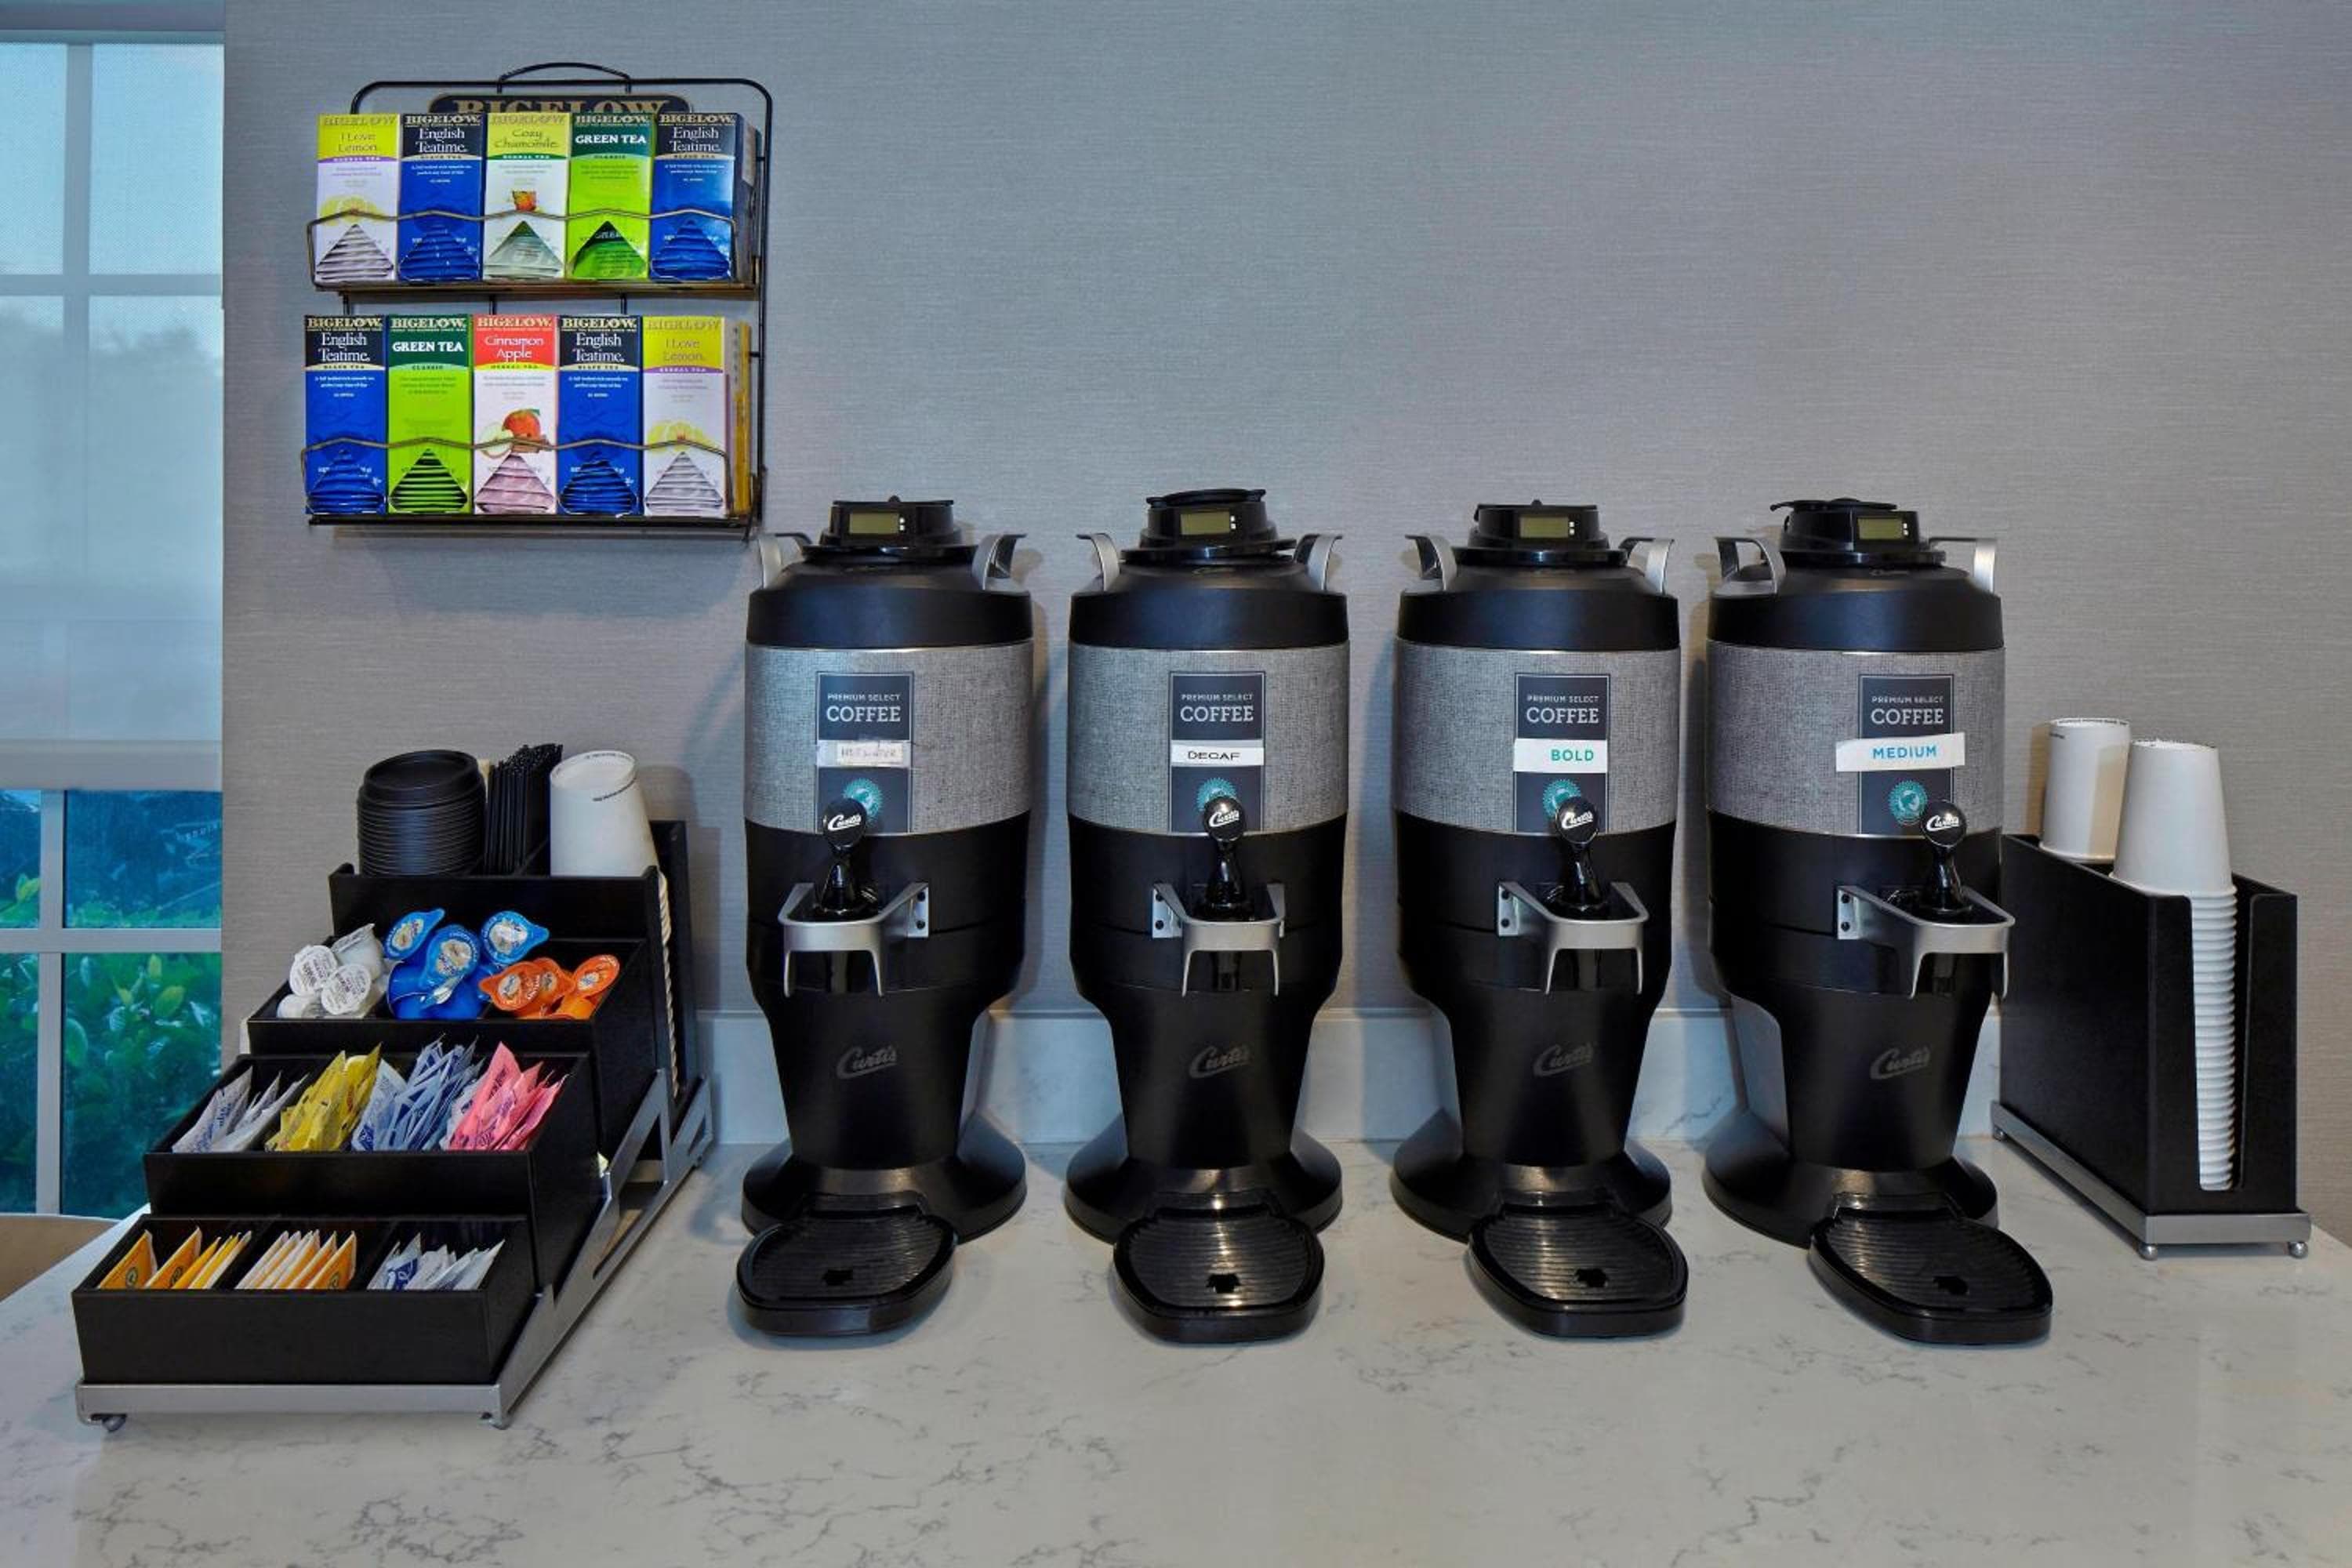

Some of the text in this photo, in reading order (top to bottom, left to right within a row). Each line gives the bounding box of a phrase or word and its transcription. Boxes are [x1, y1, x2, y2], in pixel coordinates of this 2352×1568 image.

[405, 114, 481, 124] BIGELOW
[575, 115, 649, 125] BIGELOW
[659, 114, 735, 124] BIGELOW
[419, 127, 465, 142] English
[511, 129, 543, 140] Cozy
[575, 134, 647, 144] GREEN TEA
[673, 126, 719, 141] English
[307, 318, 383, 328] BIGELOW
[391, 318, 466, 328] BIGELOW
[477, 317, 552, 328] BIGELOW
[562, 318, 637, 328] BIGELOW
[321, 332, 368, 349] English
[485, 333, 544, 347] Cinnamon
[575, 332, 622, 348] English
[392, 341, 464, 352] GREEN TEA
[495, 347, 532, 363] Apple
[827, 693, 901, 702] PREMIUM SELECT
[1222, 693, 1253, 702] SELECT
[1526, 695, 1599, 703] PREMIUM SELECT
[1871, 695, 1912, 704] PREMIUM
[826, 706, 902, 722] COFFEE
[1180, 706, 1254, 722] COFFEE
[1526, 706, 1599, 724] COFFEE
[1870, 708, 1944, 724] COFFEE
[1187, 750, 1241, 761] DECAF
[1551, 749, 1595, 762] BOLD
[1872, 745, 1937, 760] MEDIUM
[836, 1044, 898, 1080] Curtis
